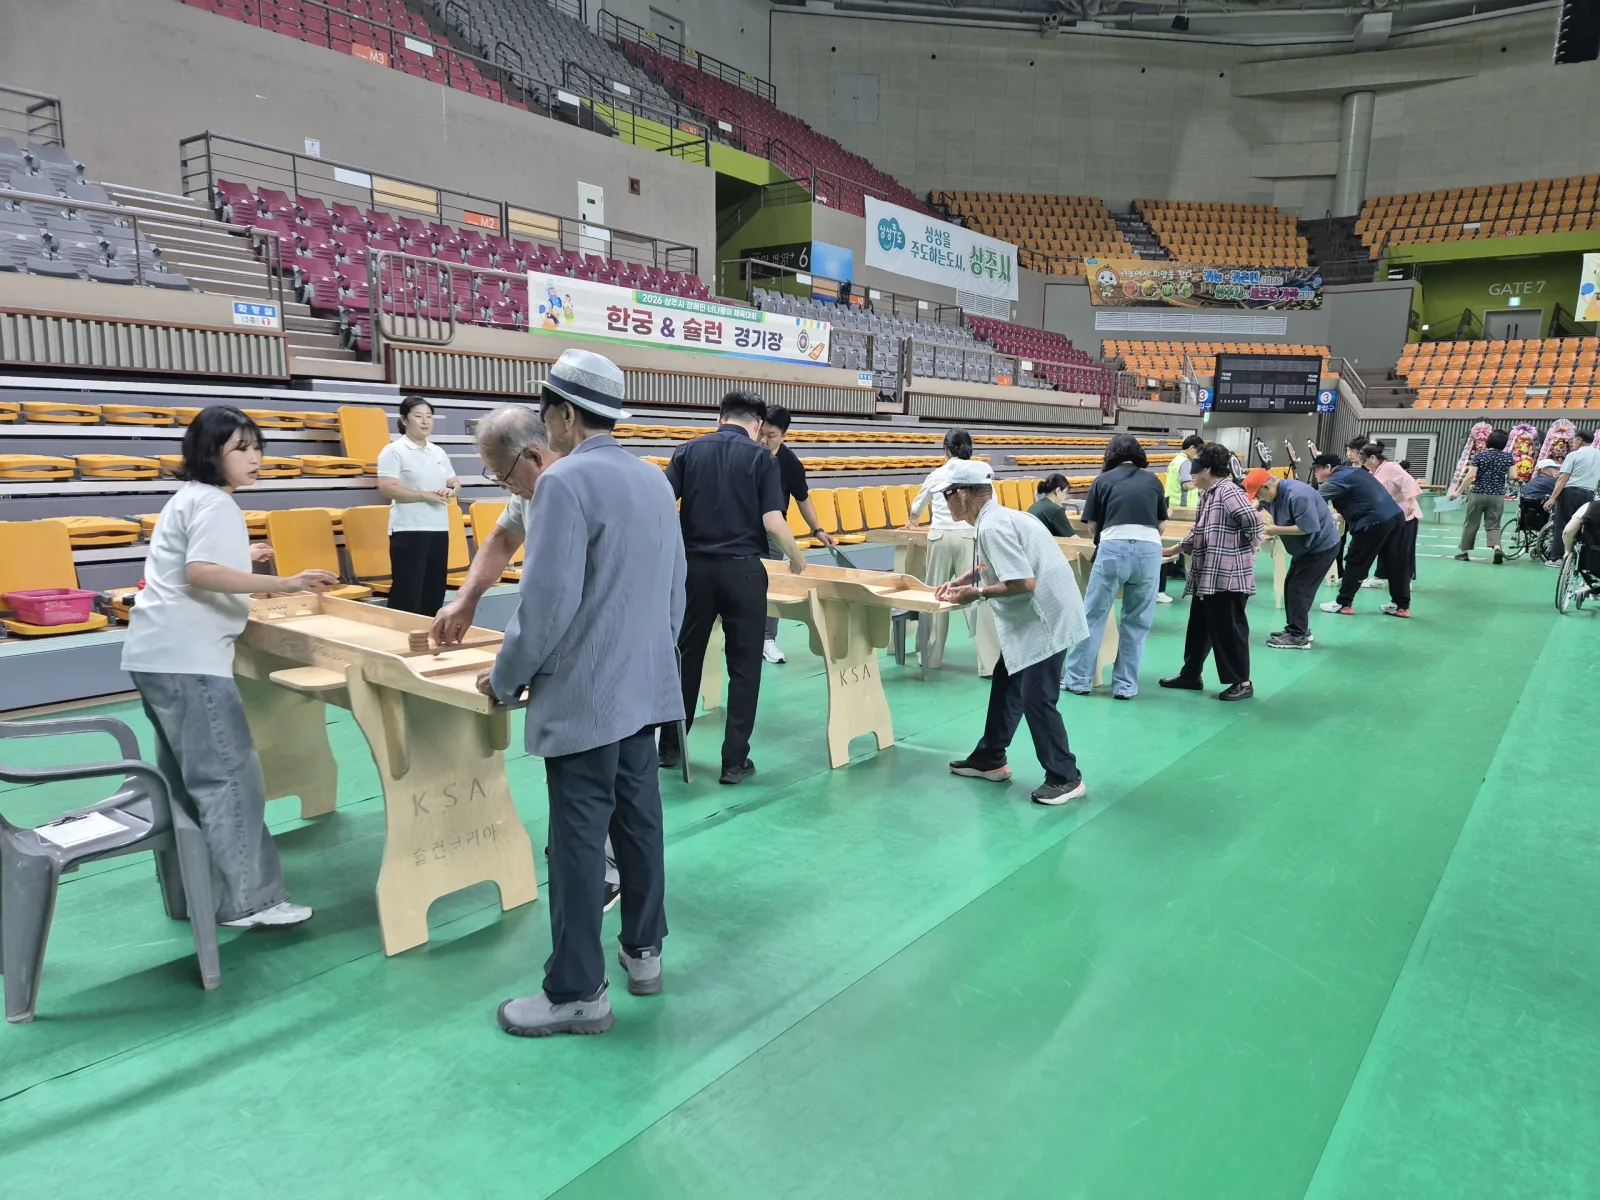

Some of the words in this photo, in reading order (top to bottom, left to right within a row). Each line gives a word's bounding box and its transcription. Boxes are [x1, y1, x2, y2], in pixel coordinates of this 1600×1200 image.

[369, 50, 385, 64] M3
[480, 216, 495, 229] M2
[879, 223, 903, 244] 상상주도
[924, 225, 951, 249] 상상을
[799, 246, 809, 268] 6
[970, 244, 1012, 284] 상주시
[1488, 282, 1532, 296] GATE
[1536, 280, 1546, 294] 7
[238, 303, 273, 316] 화장실
[642, 293, 663, 305] 2026
[664, 297, 685, 309] 상주시
[686, 301, 706, 312] 장애인
[606, 304, 654, 336] 한궁
[660, 316, 675, 338] &
[683, 317, 723, 345] 슐런
[734, 326, 784, 352] 경기장
[840, 664, 871, 686] KSA
[412, 778, 486, 817] KSA
[413, 823, 497, 866] 슐런코리아
